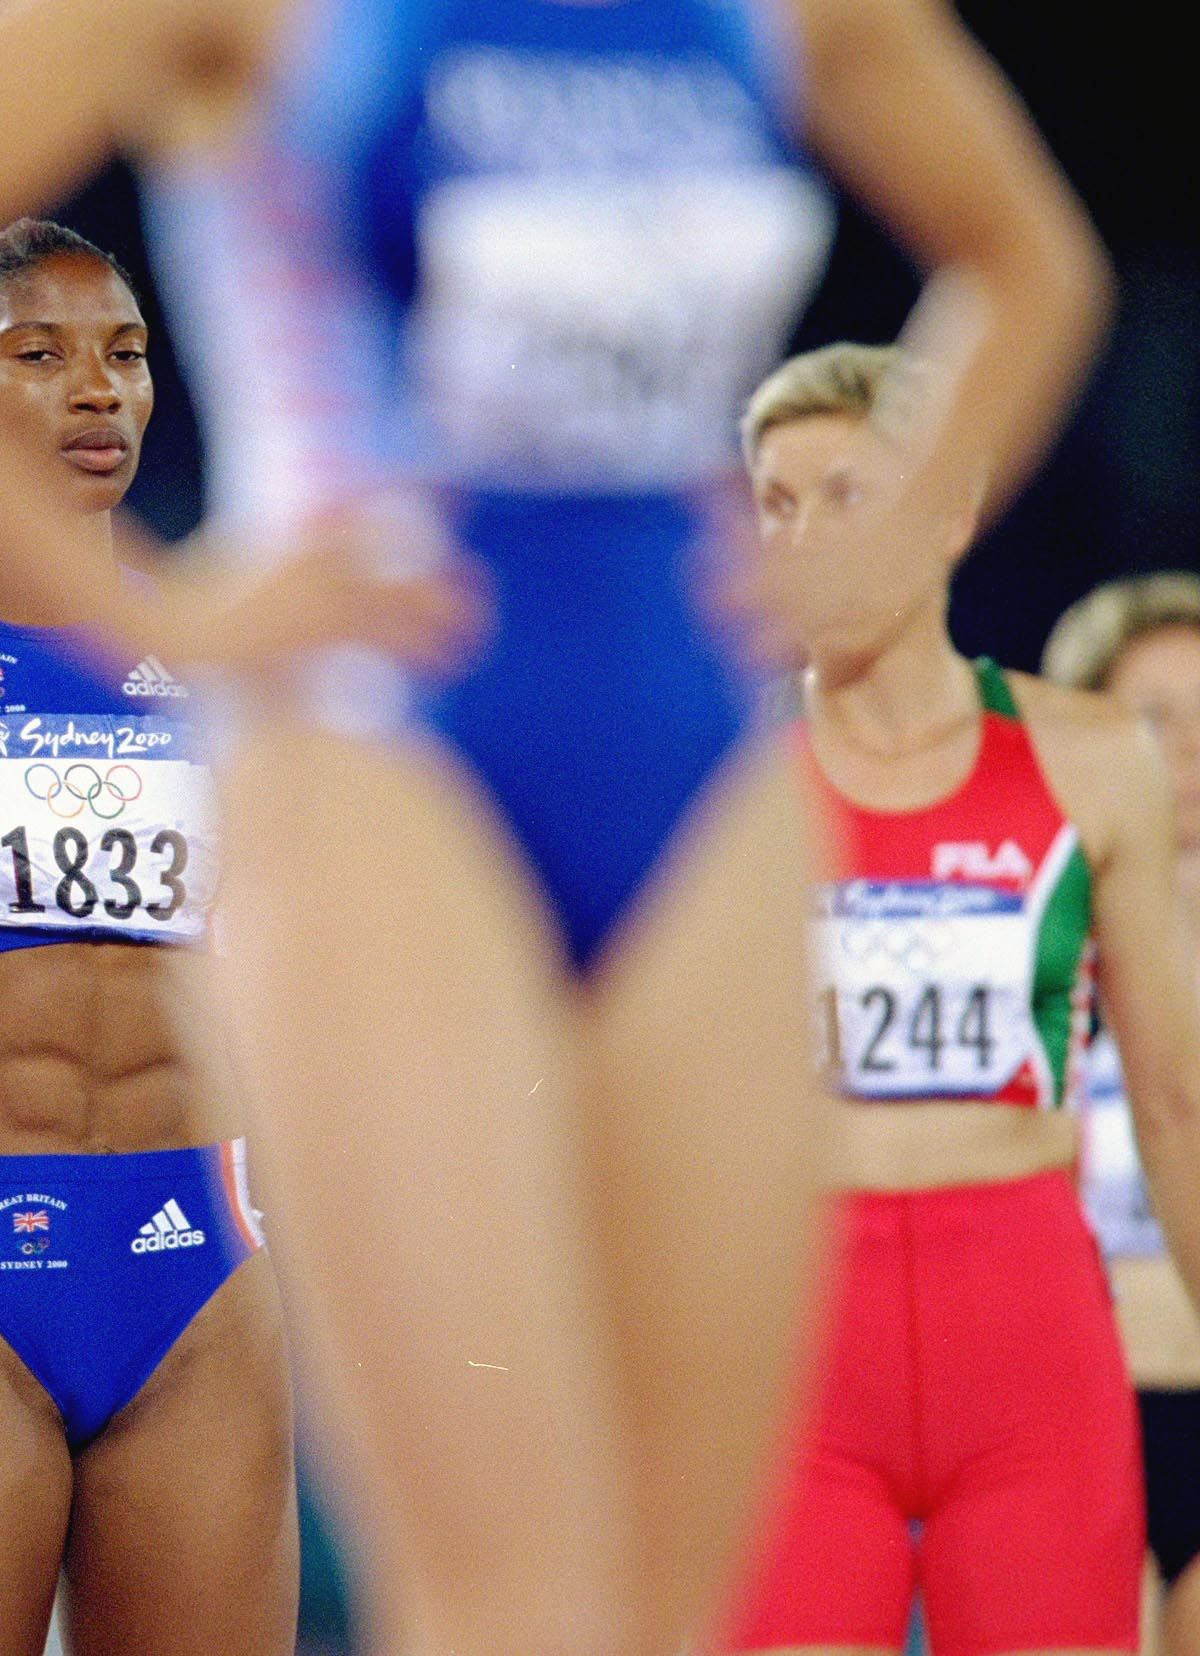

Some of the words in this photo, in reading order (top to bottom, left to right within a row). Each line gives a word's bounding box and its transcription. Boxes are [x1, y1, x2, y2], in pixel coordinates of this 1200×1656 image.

[5, 704, 26, 713] 2000
[20, 718, 114, 759] Sydney
[116, 727, 172, 753] 2000
[1, 825, 189, 921] 1833
[818, 982, 996, 1073] 1244
[26, 1193, 68, 1211] BRITAIN
[131, 1230, 206, 1254] adidas
[0, 1261, 43, 1270] SYDNEY
[46, 1260, 68, 1269] 2000
